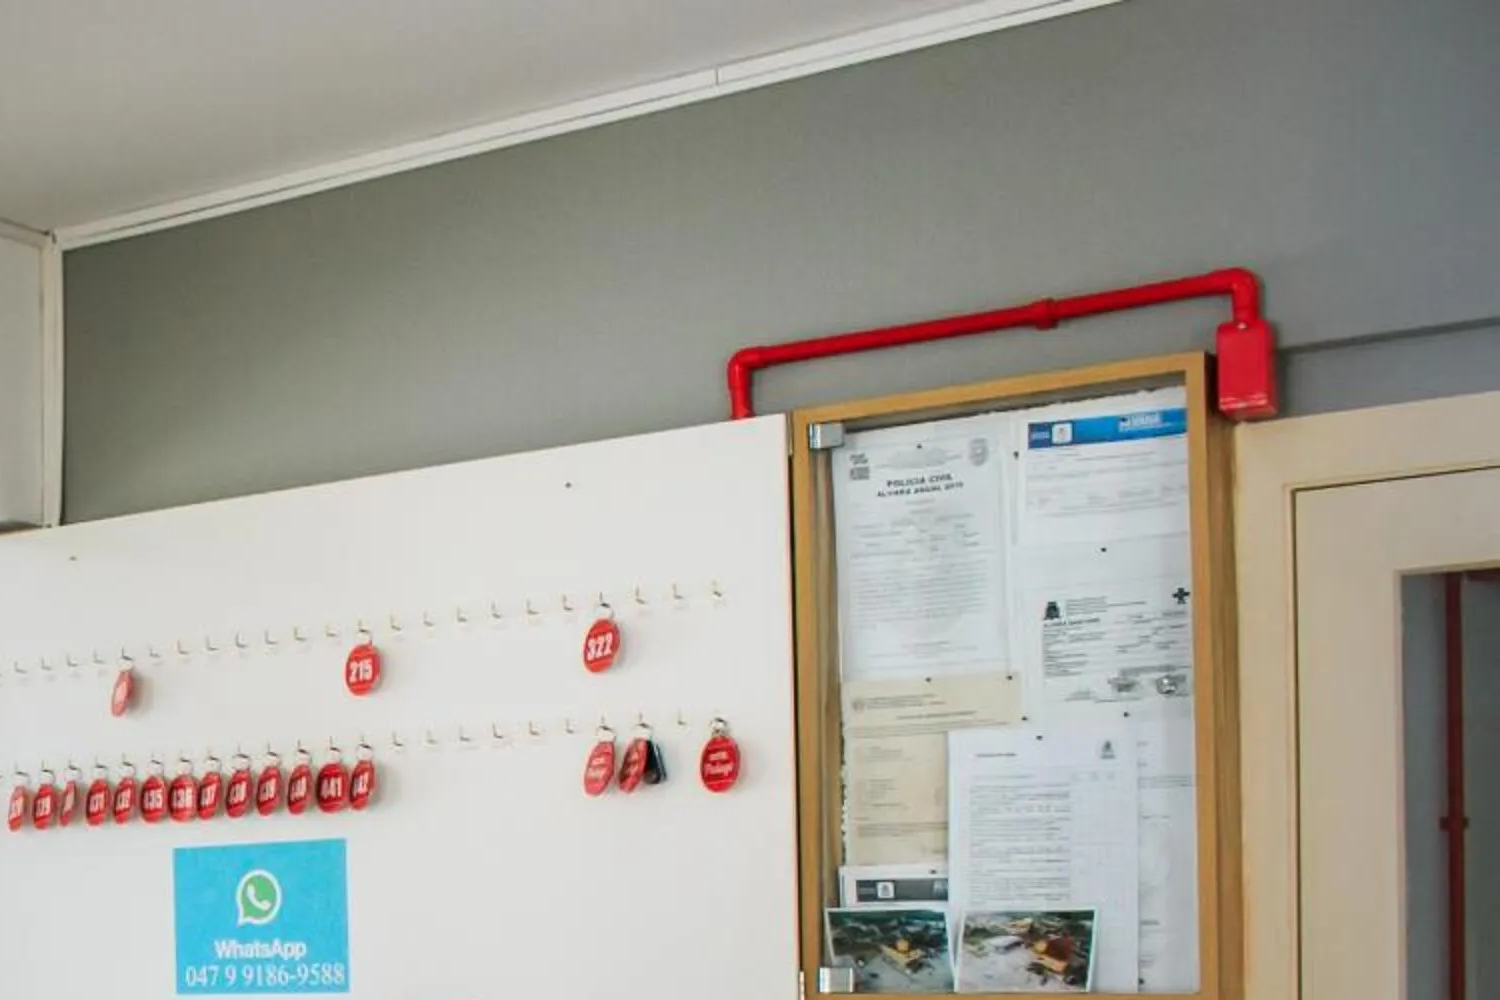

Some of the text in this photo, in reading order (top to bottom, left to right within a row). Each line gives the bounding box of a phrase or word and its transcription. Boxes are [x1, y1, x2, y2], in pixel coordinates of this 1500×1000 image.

[349, 658, 373, 683] 215
[214, 938, 307, 961] WhatsApp
[185, 962, 346, 987] 047 9 9186-9588
